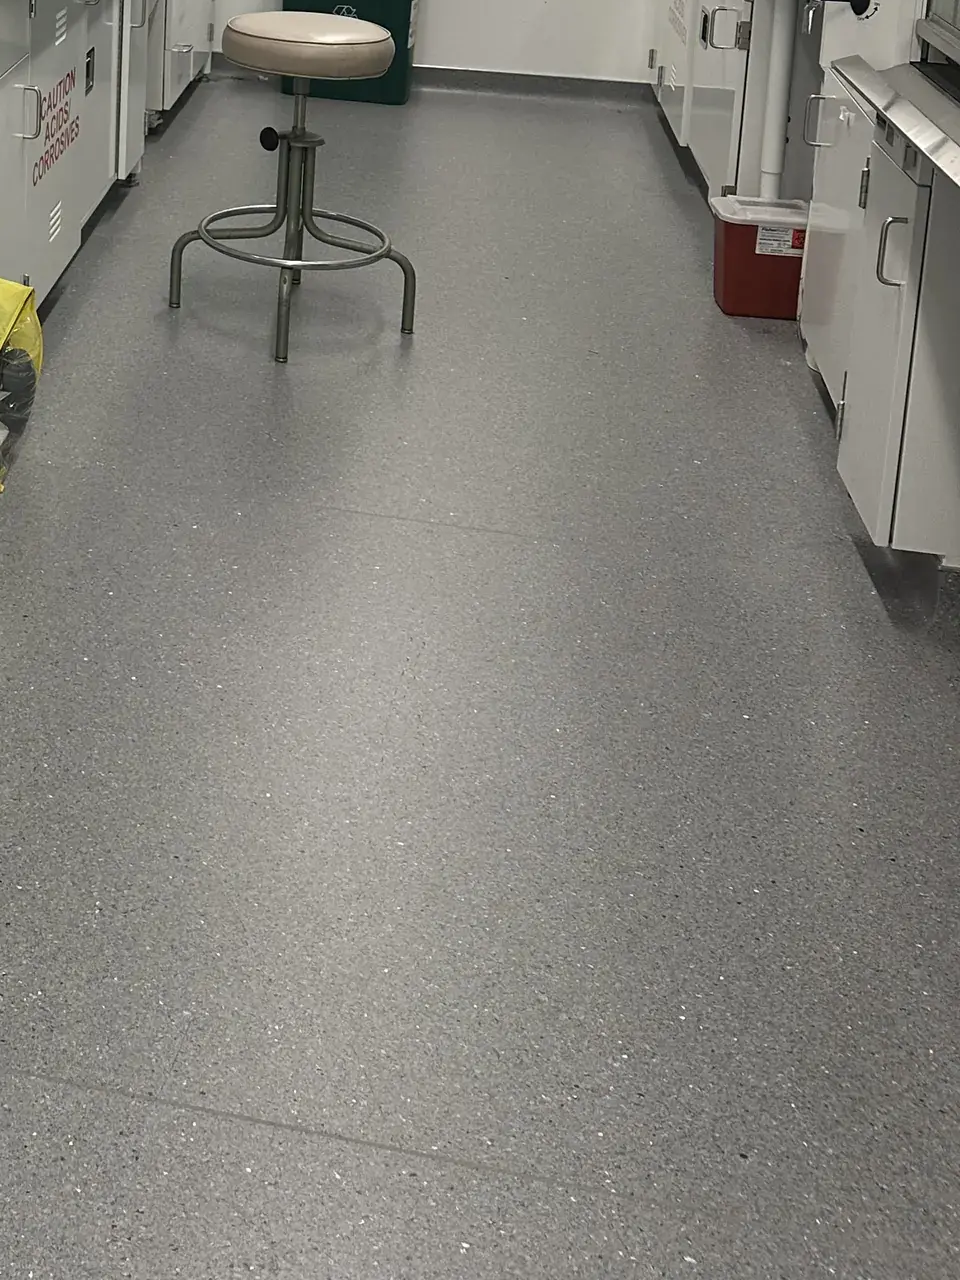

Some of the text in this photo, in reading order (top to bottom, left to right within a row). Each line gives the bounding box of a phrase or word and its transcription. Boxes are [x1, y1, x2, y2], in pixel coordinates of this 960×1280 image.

[41, 67, 76, 121] CAUTION
[44, 97, 72, 147] ACIDS/
[33, 115, 80, 187] CORROSIVES
